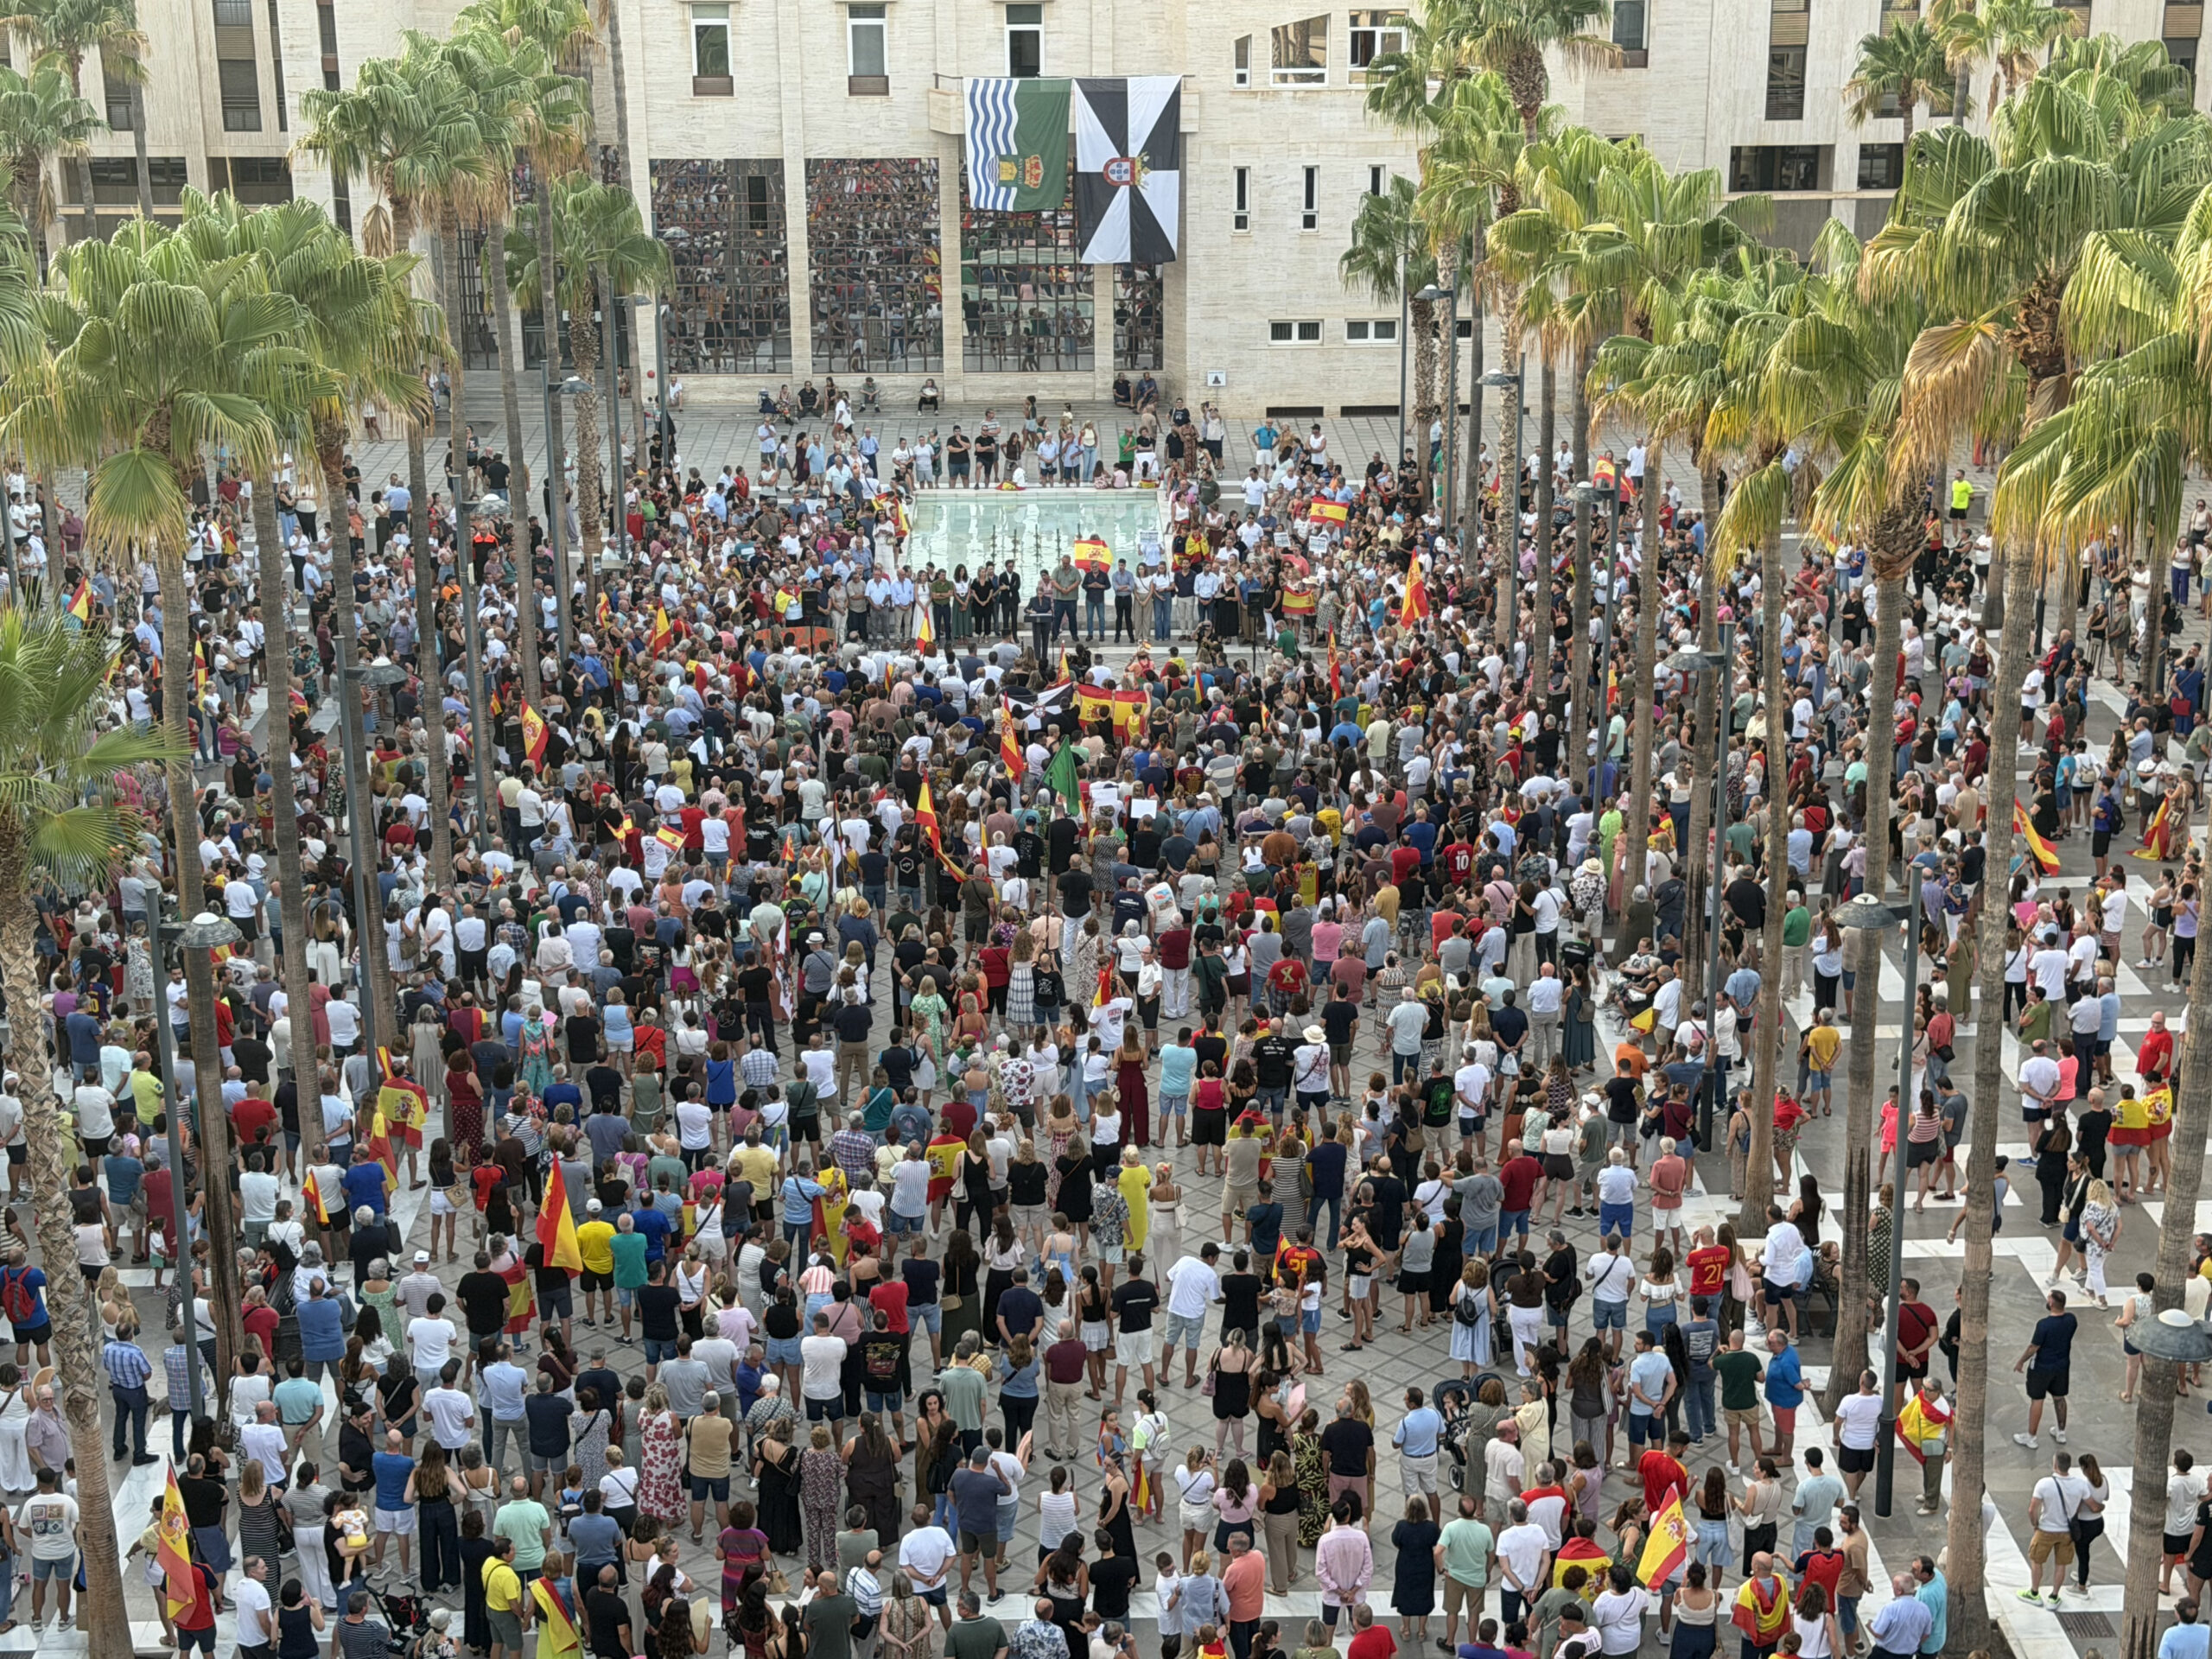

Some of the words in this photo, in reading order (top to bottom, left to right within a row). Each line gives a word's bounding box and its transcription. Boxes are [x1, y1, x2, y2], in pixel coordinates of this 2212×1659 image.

[1455, 855, 1469, 871] 10
[233, 969, 244, 986] 2
[1699, 1255, 1714, 1264] JOSE
[1715, 1254, 1726, 1262] LUIS
[1703, 1263, 1722, 1285] 21
[1586, 1637, 1600, 1653] ULL
